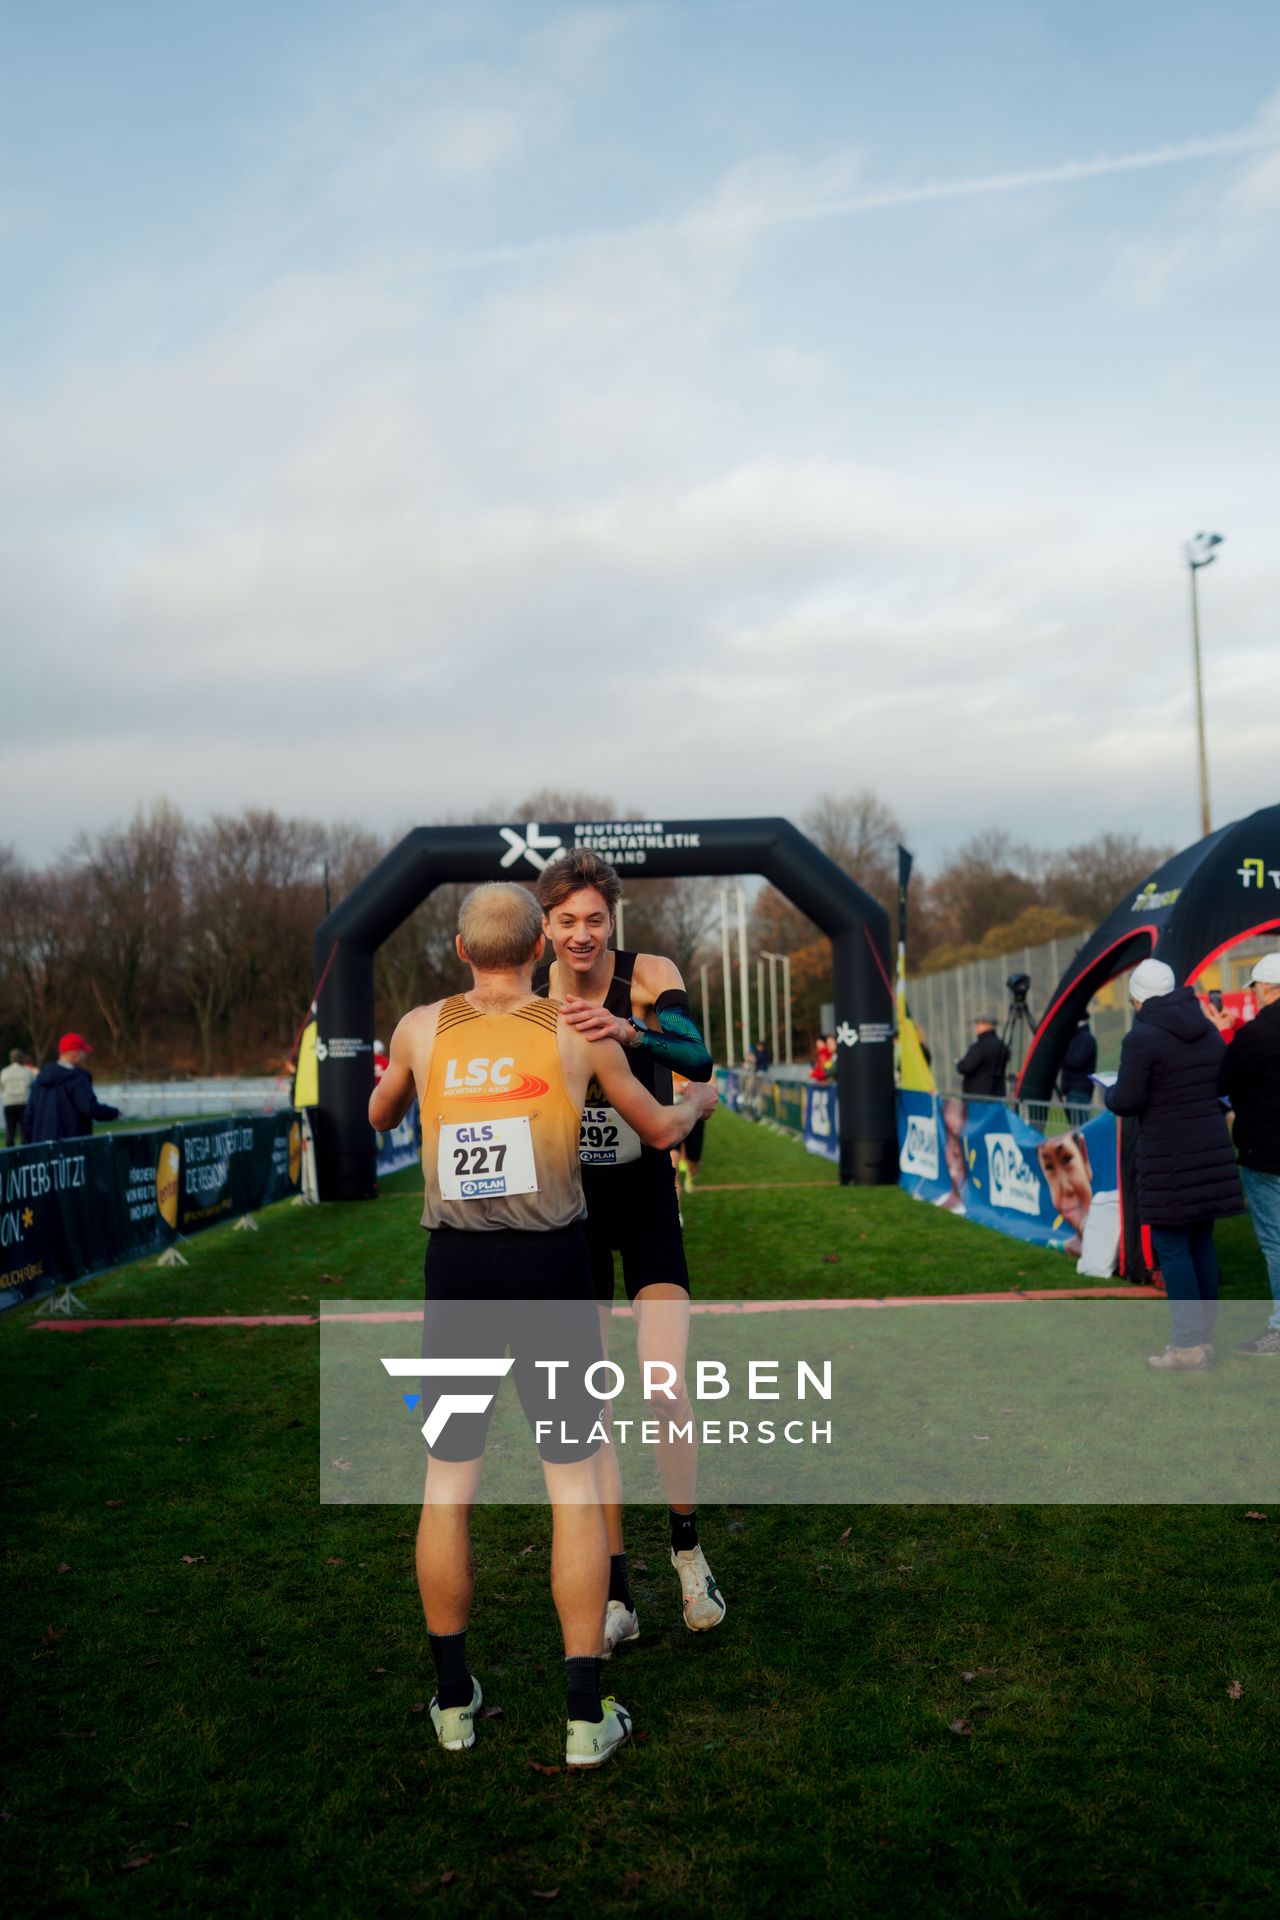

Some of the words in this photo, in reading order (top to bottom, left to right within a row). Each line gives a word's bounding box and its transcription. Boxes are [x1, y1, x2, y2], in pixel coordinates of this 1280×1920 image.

[574, 823, 663, 836] DEUTSCHER
[574, 833, 700, 850] LEICHTATHLETIK
[596, 851, 647, 864] BAND
[445, 1057, 515, 1088] LSC
[453, 1145, 507, 1175] 227
[478, 1180, 504, 1190] PLAN
